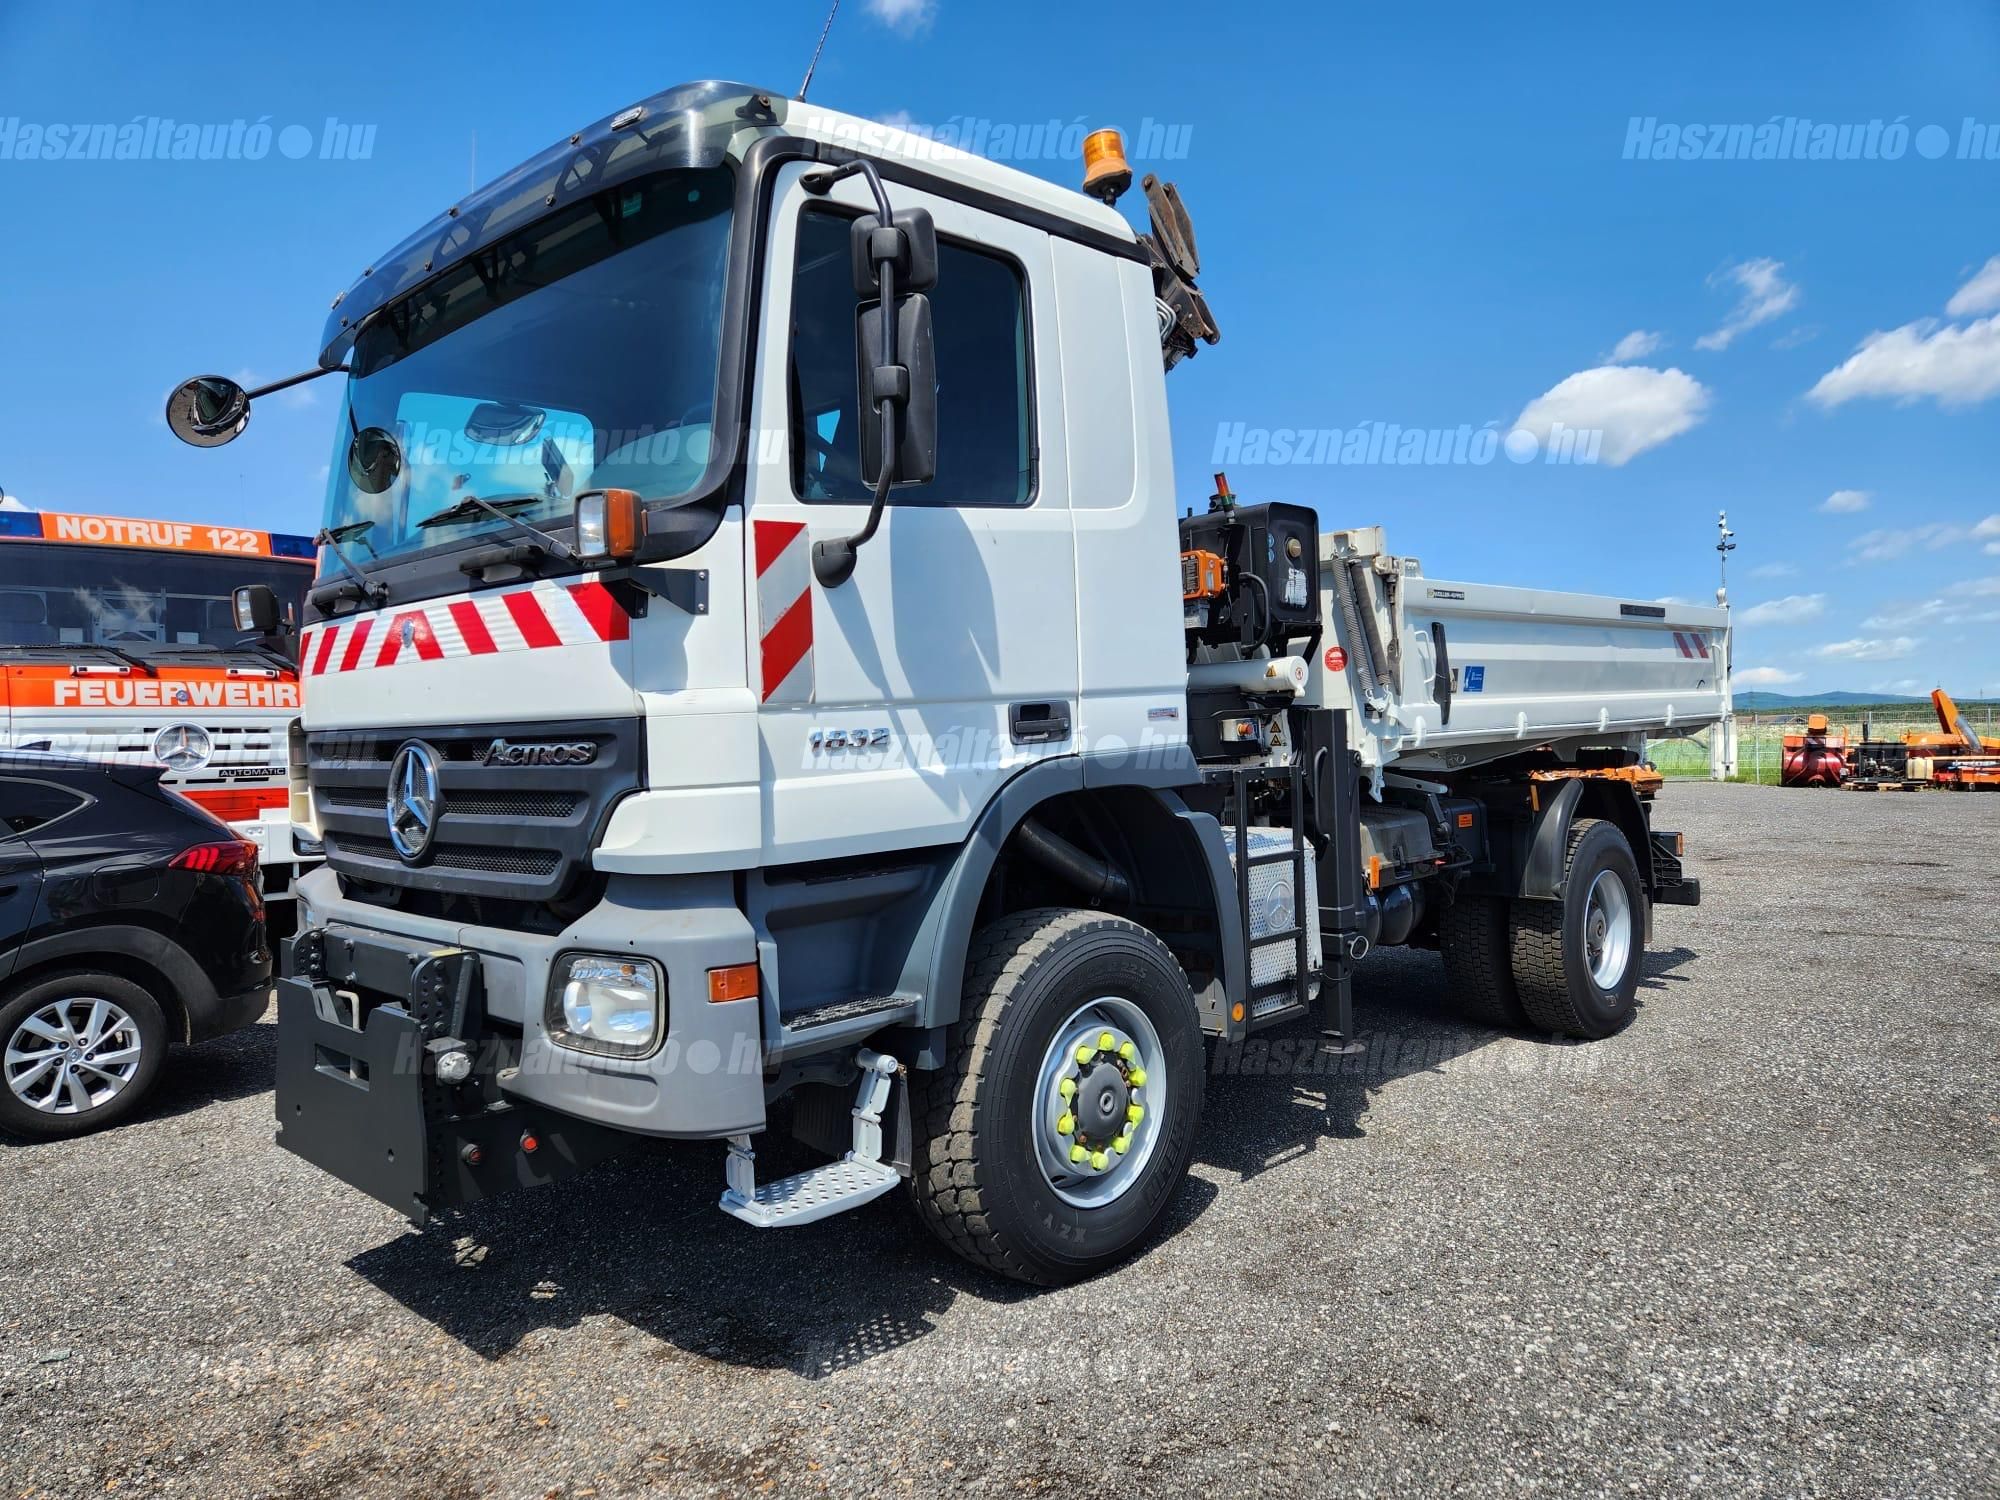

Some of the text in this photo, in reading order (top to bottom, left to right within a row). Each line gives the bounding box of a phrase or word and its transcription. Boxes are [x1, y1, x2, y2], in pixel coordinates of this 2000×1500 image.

[56, 516, 259, 553] NOTRUF 122
[54, 680, 298, 707] FEUERWEHR
[809, 727, 890, 752] 1832
[220, 768, 285, 777] AUTOMATIC
